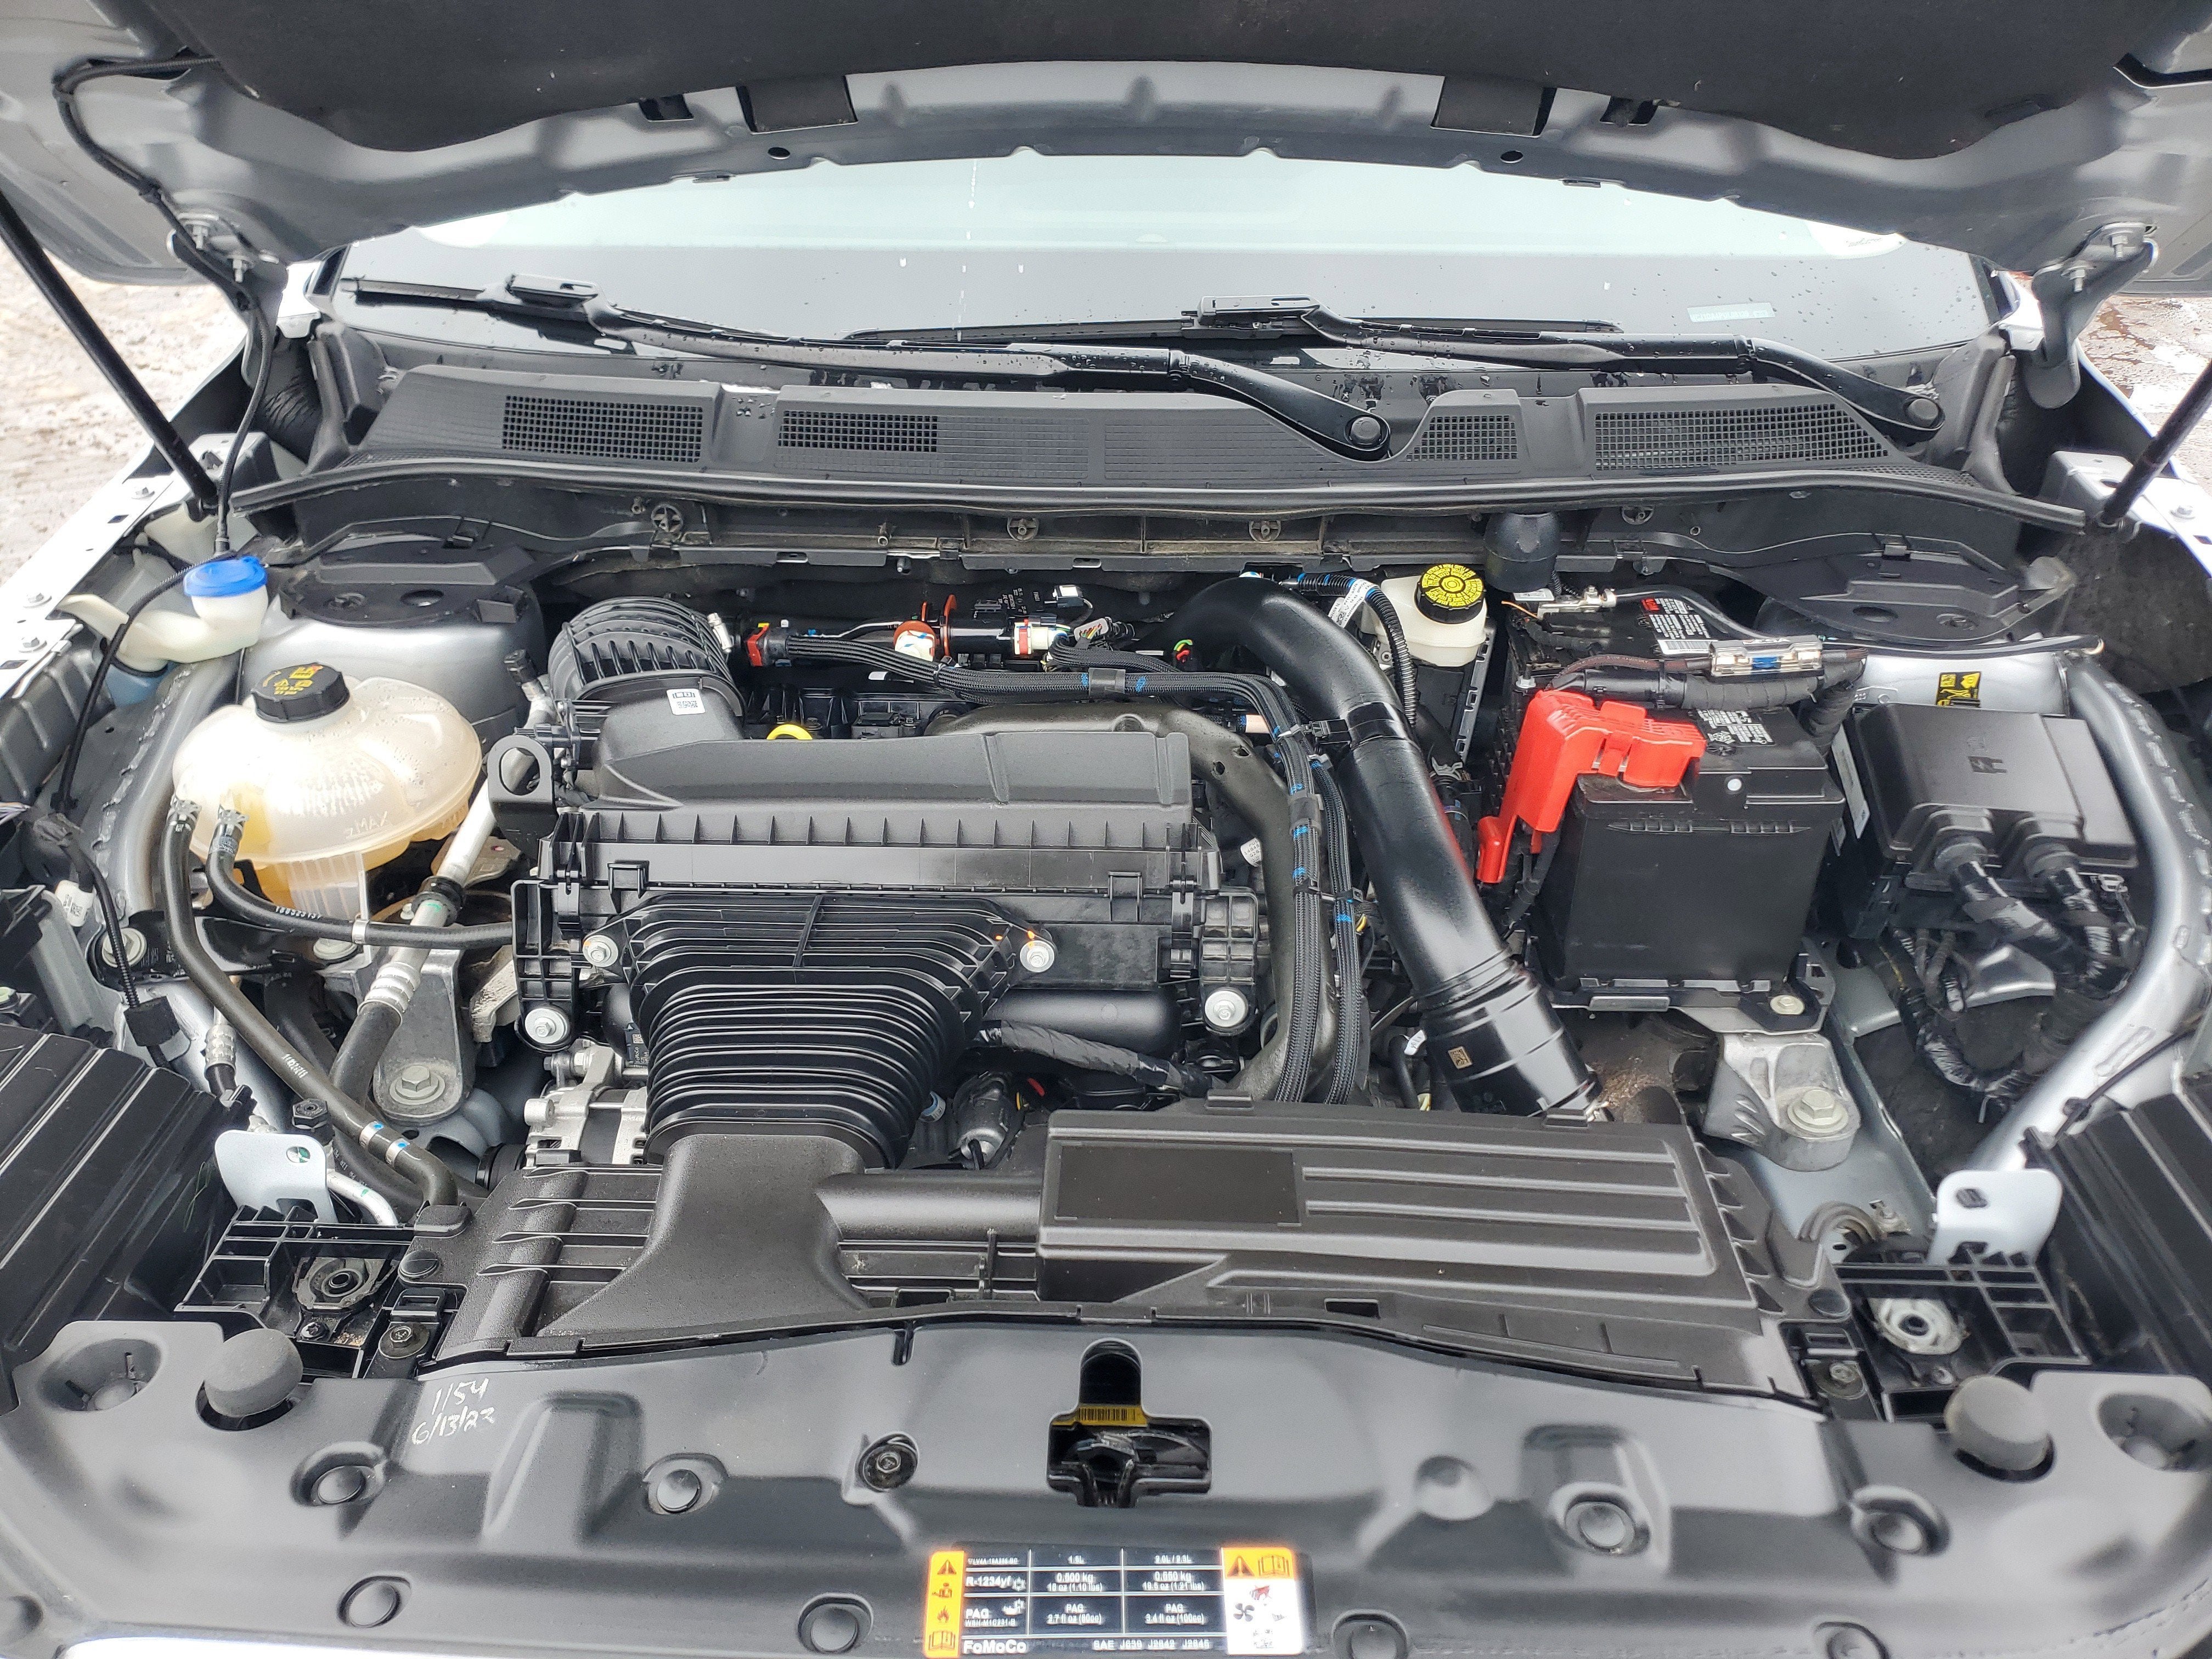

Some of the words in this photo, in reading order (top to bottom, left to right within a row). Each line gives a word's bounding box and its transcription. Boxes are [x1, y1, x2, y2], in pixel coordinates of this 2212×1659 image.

[431, 1378, 489, 1415] 1154
[966, 1576, 1012, 1588] R-1234yf
[963, 1639, 1026, 1654] FoMoCo
[1093, 1639, 1114, 1649] SAE
